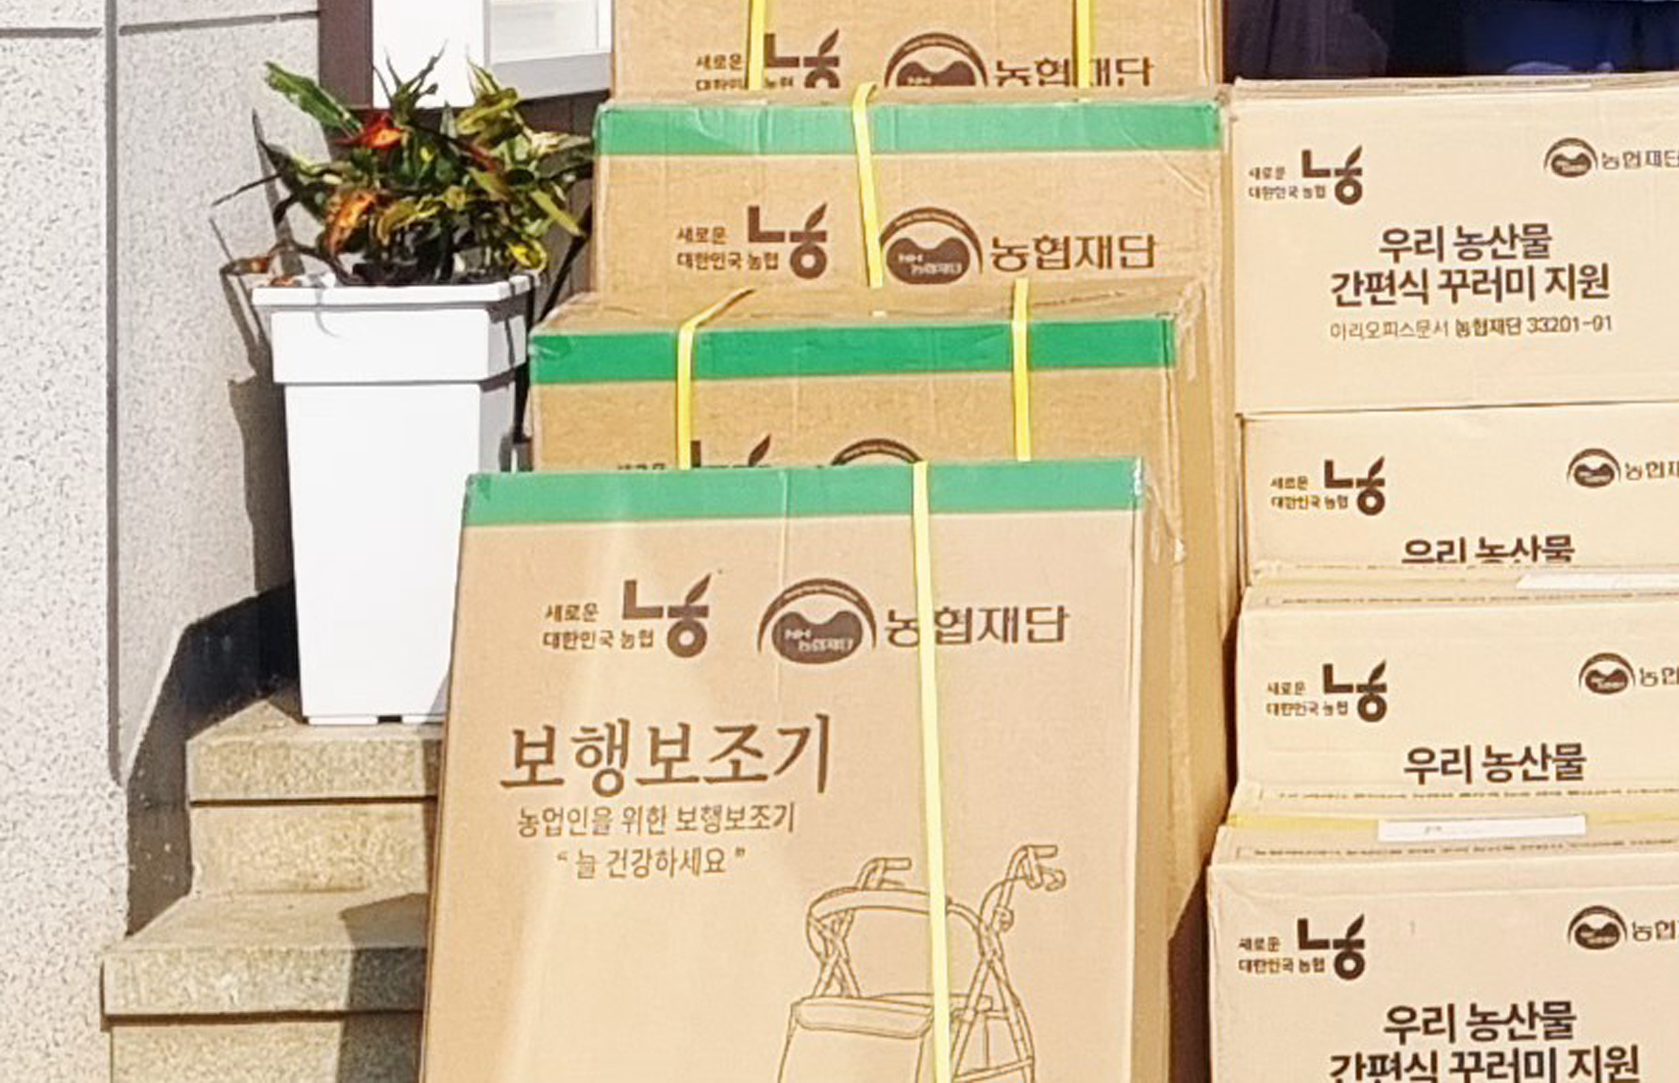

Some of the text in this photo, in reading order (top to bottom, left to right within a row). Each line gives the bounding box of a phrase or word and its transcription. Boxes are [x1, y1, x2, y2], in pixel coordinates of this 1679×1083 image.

[991, 234, 1156, 272] 농협재단
[1379, 223, 1552, 263] 우리 농산물
[1331, 263, 1611, 308] 간편식 꾸러미 지원
[500, 713, 831, 798] 보행보조기
[1404, 743, 1588, 785] 우리 농산물
[517, 802, 796, 838] 농업인을 위한 보행보조기
[1384, 1001, 1577, 1045] 우리 농산물
[1330, 1045, 1640, 1083] 간편식 꾸러미 지원
